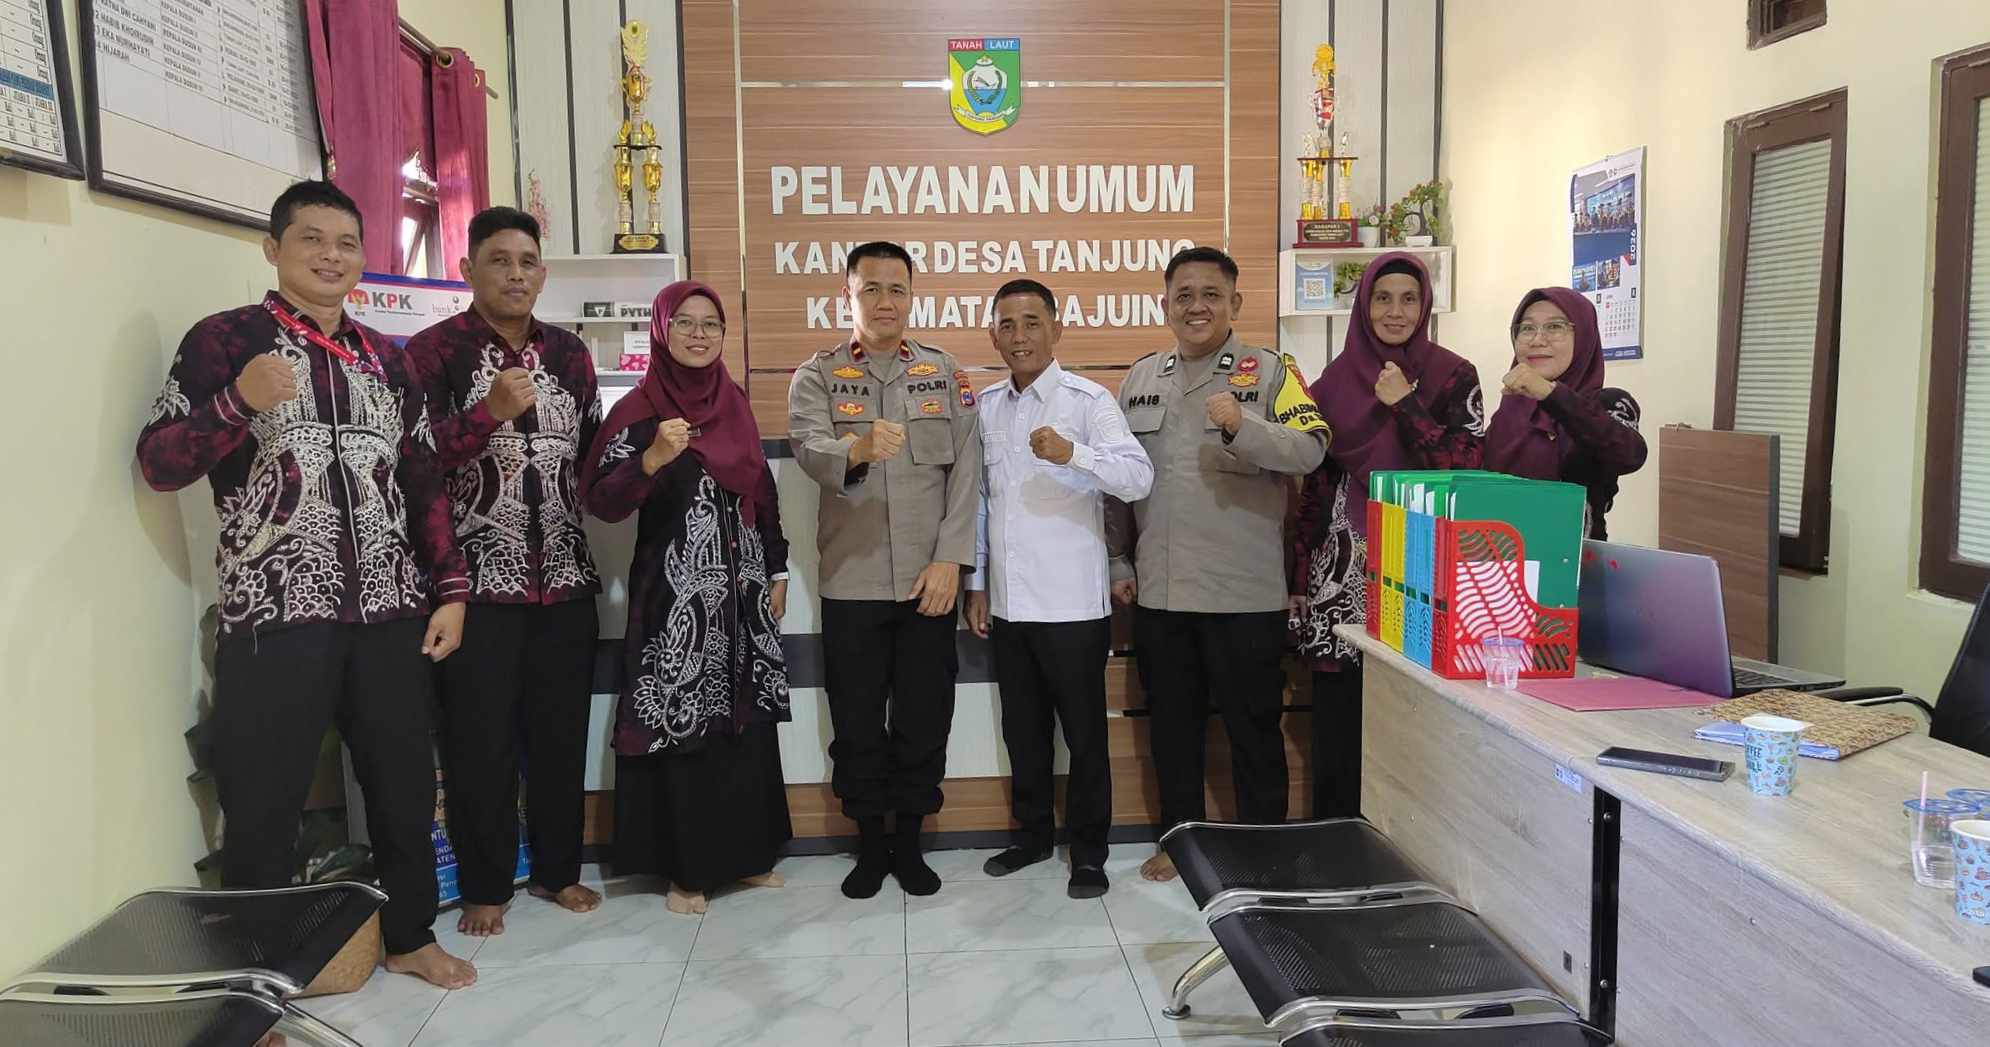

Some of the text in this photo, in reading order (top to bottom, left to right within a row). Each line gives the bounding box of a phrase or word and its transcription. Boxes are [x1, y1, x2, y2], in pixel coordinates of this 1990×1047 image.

[950, 40, 1015, 49] TANAH LAUT
[770, 164, 1195, 215] PELAYANAN UMUM
[774, 240, 929, 274] KANR
[933, 240, 1027, 274] DESA
[371, 291, 413, 310] KPK
[1056, 293, 1166, 328] AJUIN
[831, 380, 947, 397] JAYA POLRI
